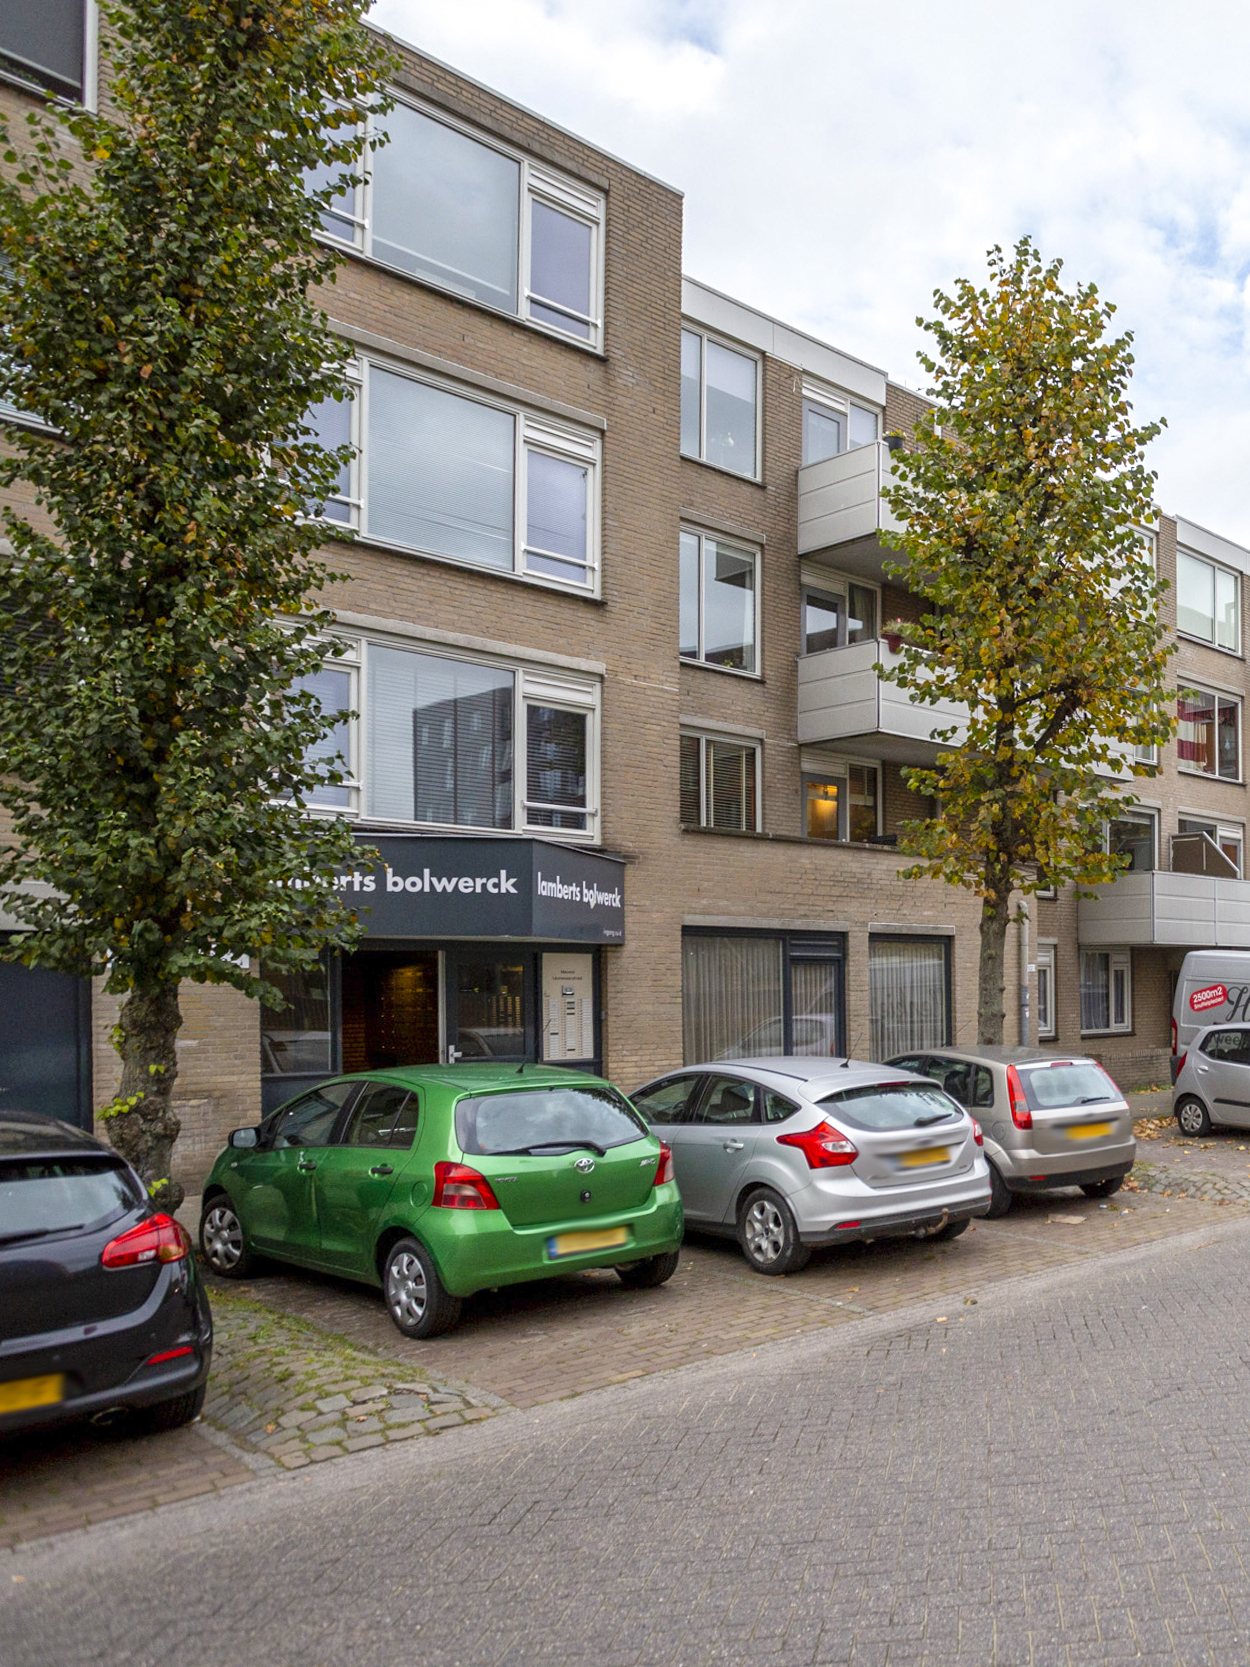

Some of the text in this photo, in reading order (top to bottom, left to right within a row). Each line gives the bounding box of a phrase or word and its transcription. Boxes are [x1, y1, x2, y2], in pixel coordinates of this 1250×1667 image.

[386, 867, 519, 894] bolwerck
[537, 871, 621, 908] lamberts bolwerck
[1193, 986, 1222, 1003] 2500m2
